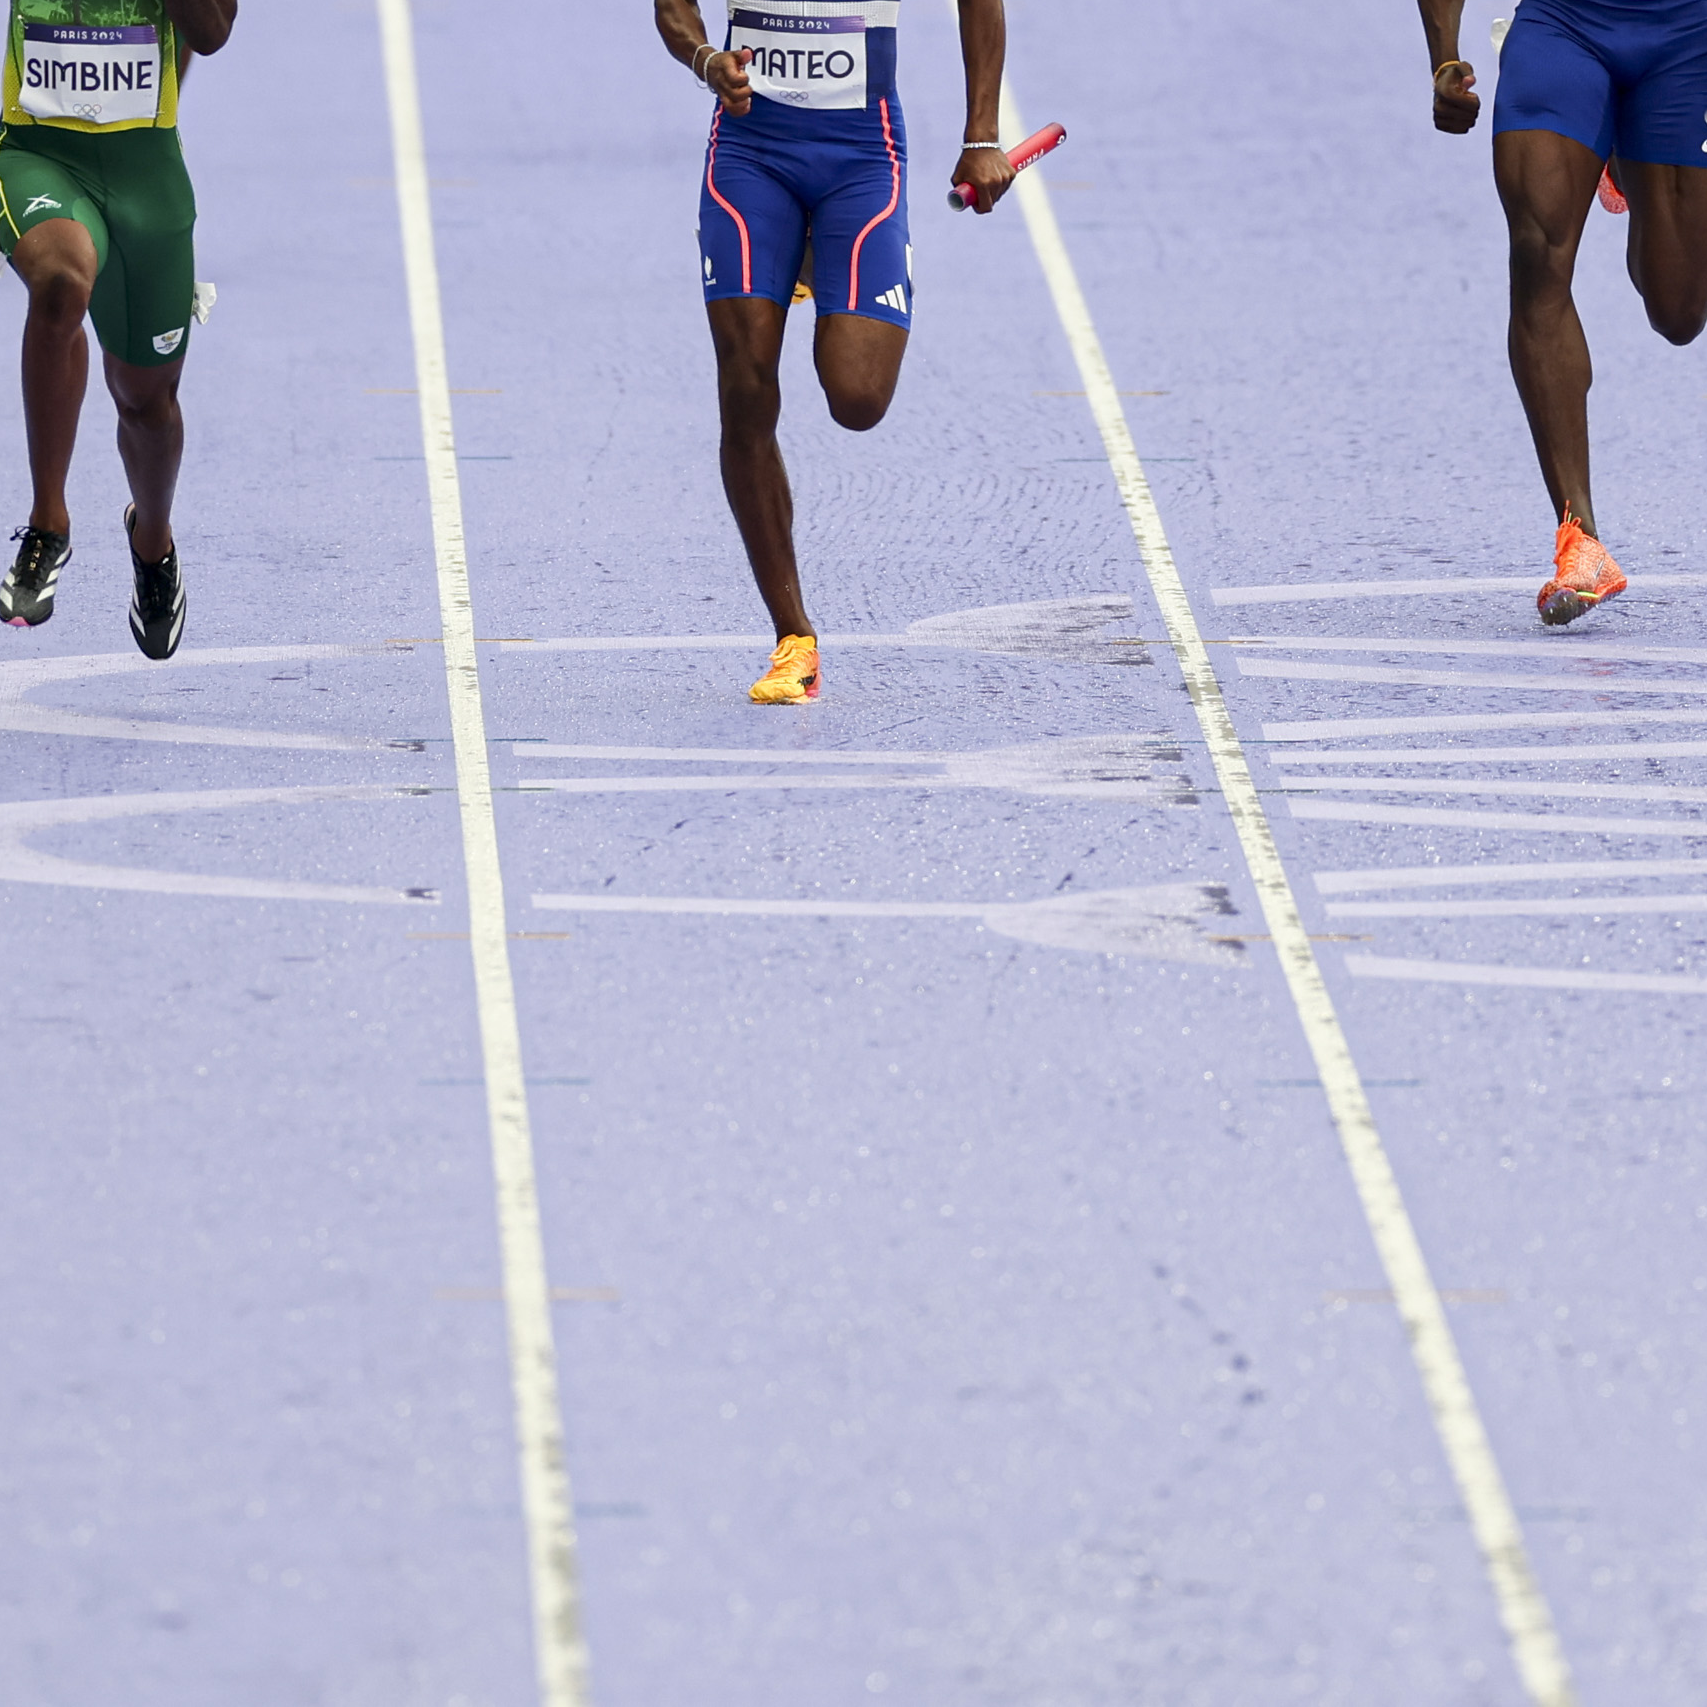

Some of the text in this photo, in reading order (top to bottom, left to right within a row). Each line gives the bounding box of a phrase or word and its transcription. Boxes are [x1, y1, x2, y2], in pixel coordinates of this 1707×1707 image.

[91, 30, 123, 41] 2024
[798, 20, 830, 30] 2024
[741, 44, 855, 79] MATEO
[26, 58, 153, 92] SIMBINE
